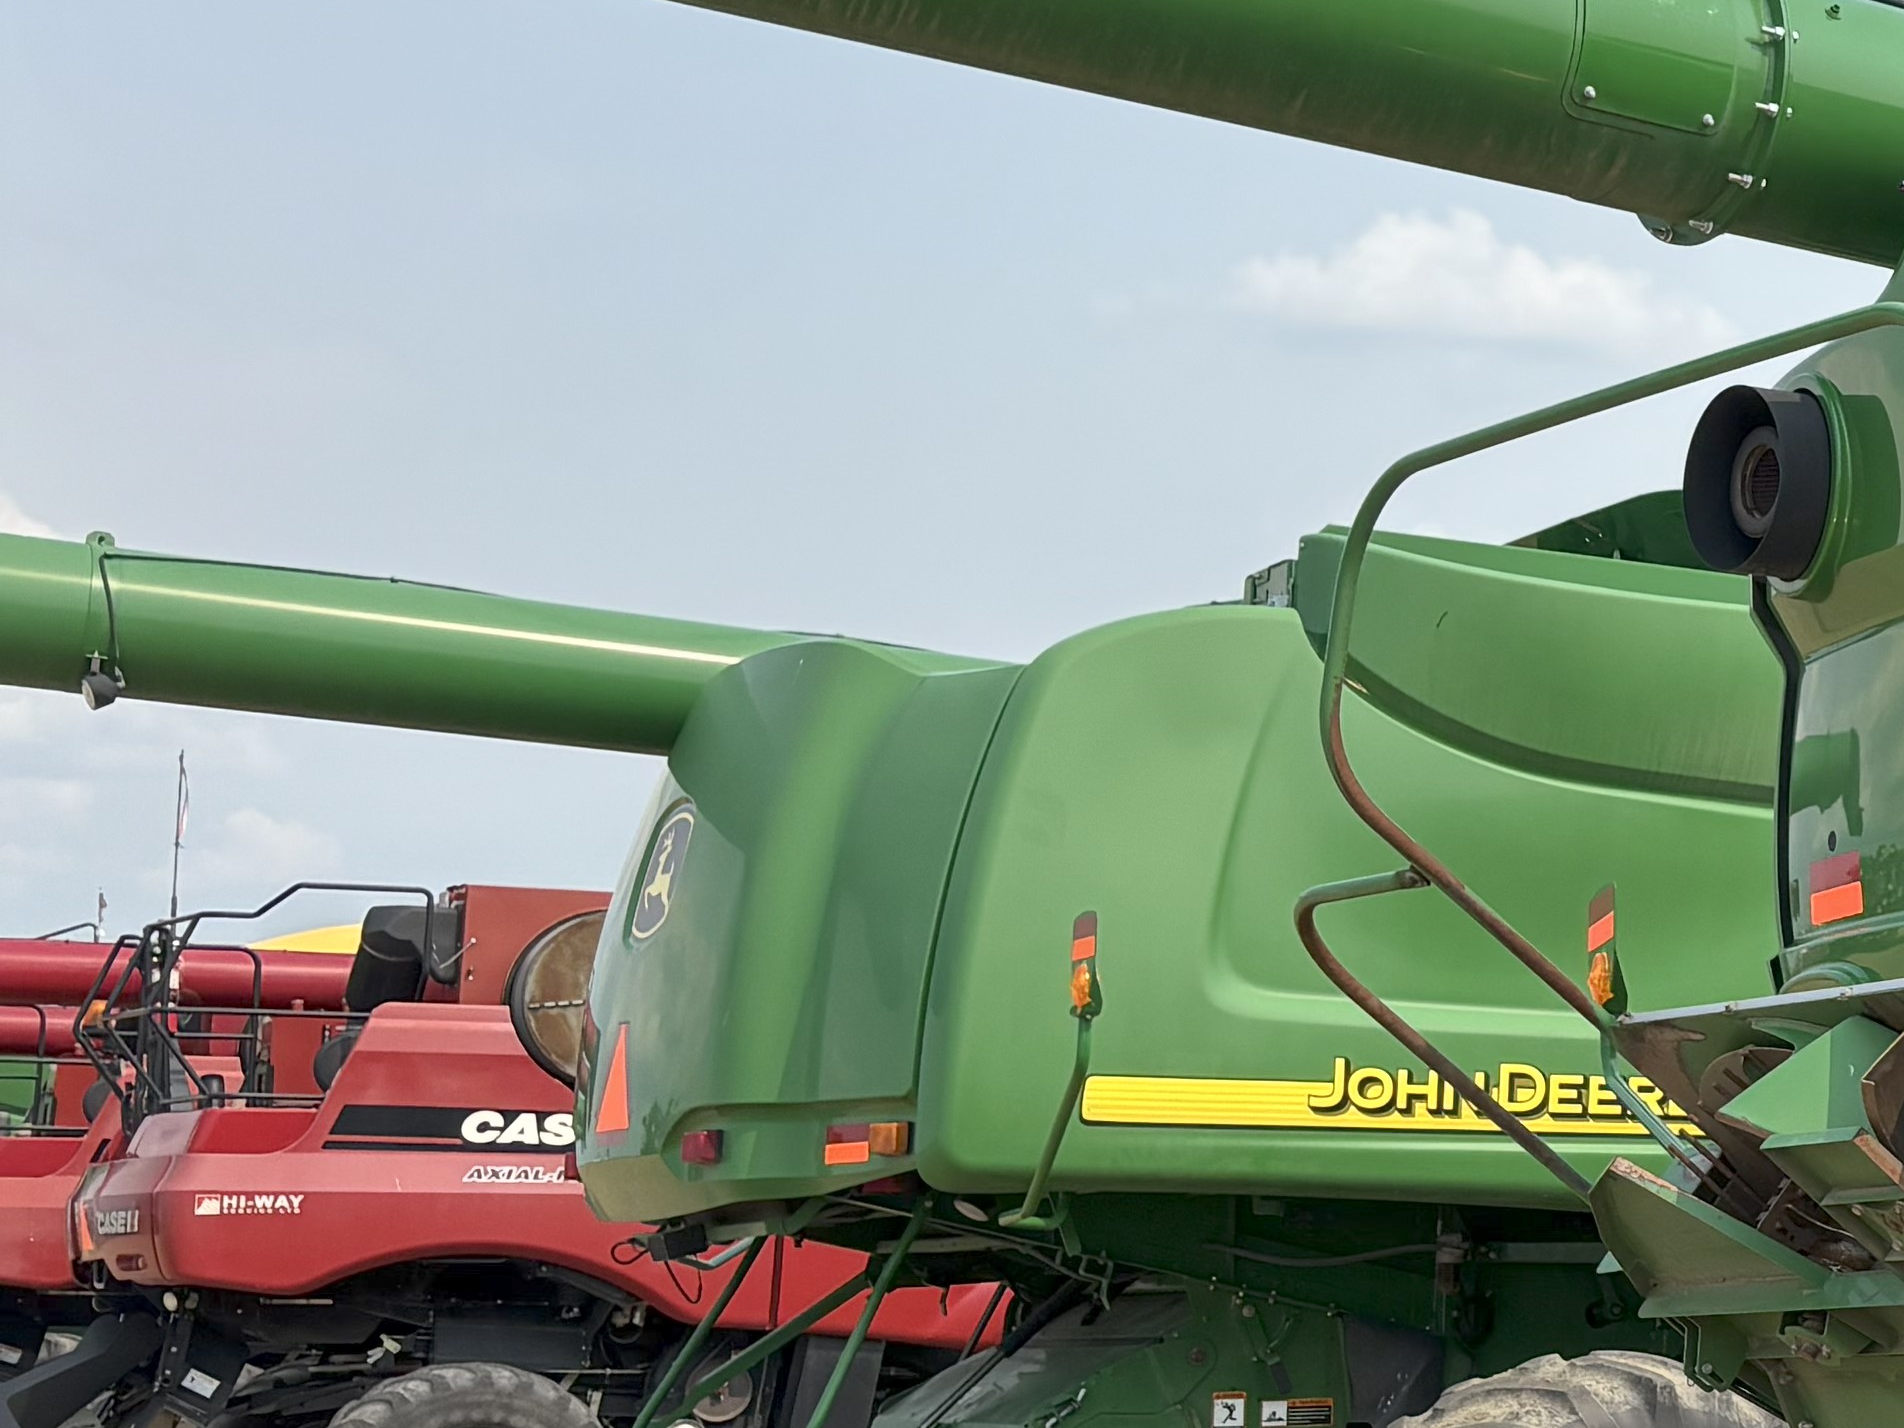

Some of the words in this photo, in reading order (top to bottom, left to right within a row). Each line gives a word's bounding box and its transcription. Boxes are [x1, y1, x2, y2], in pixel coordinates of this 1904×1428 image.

[1497, 1062, 1688, 1120] DEER
[461, 1110, 576, 1146] CAS
[222, 1193, 305, 1209] HI-WAY
